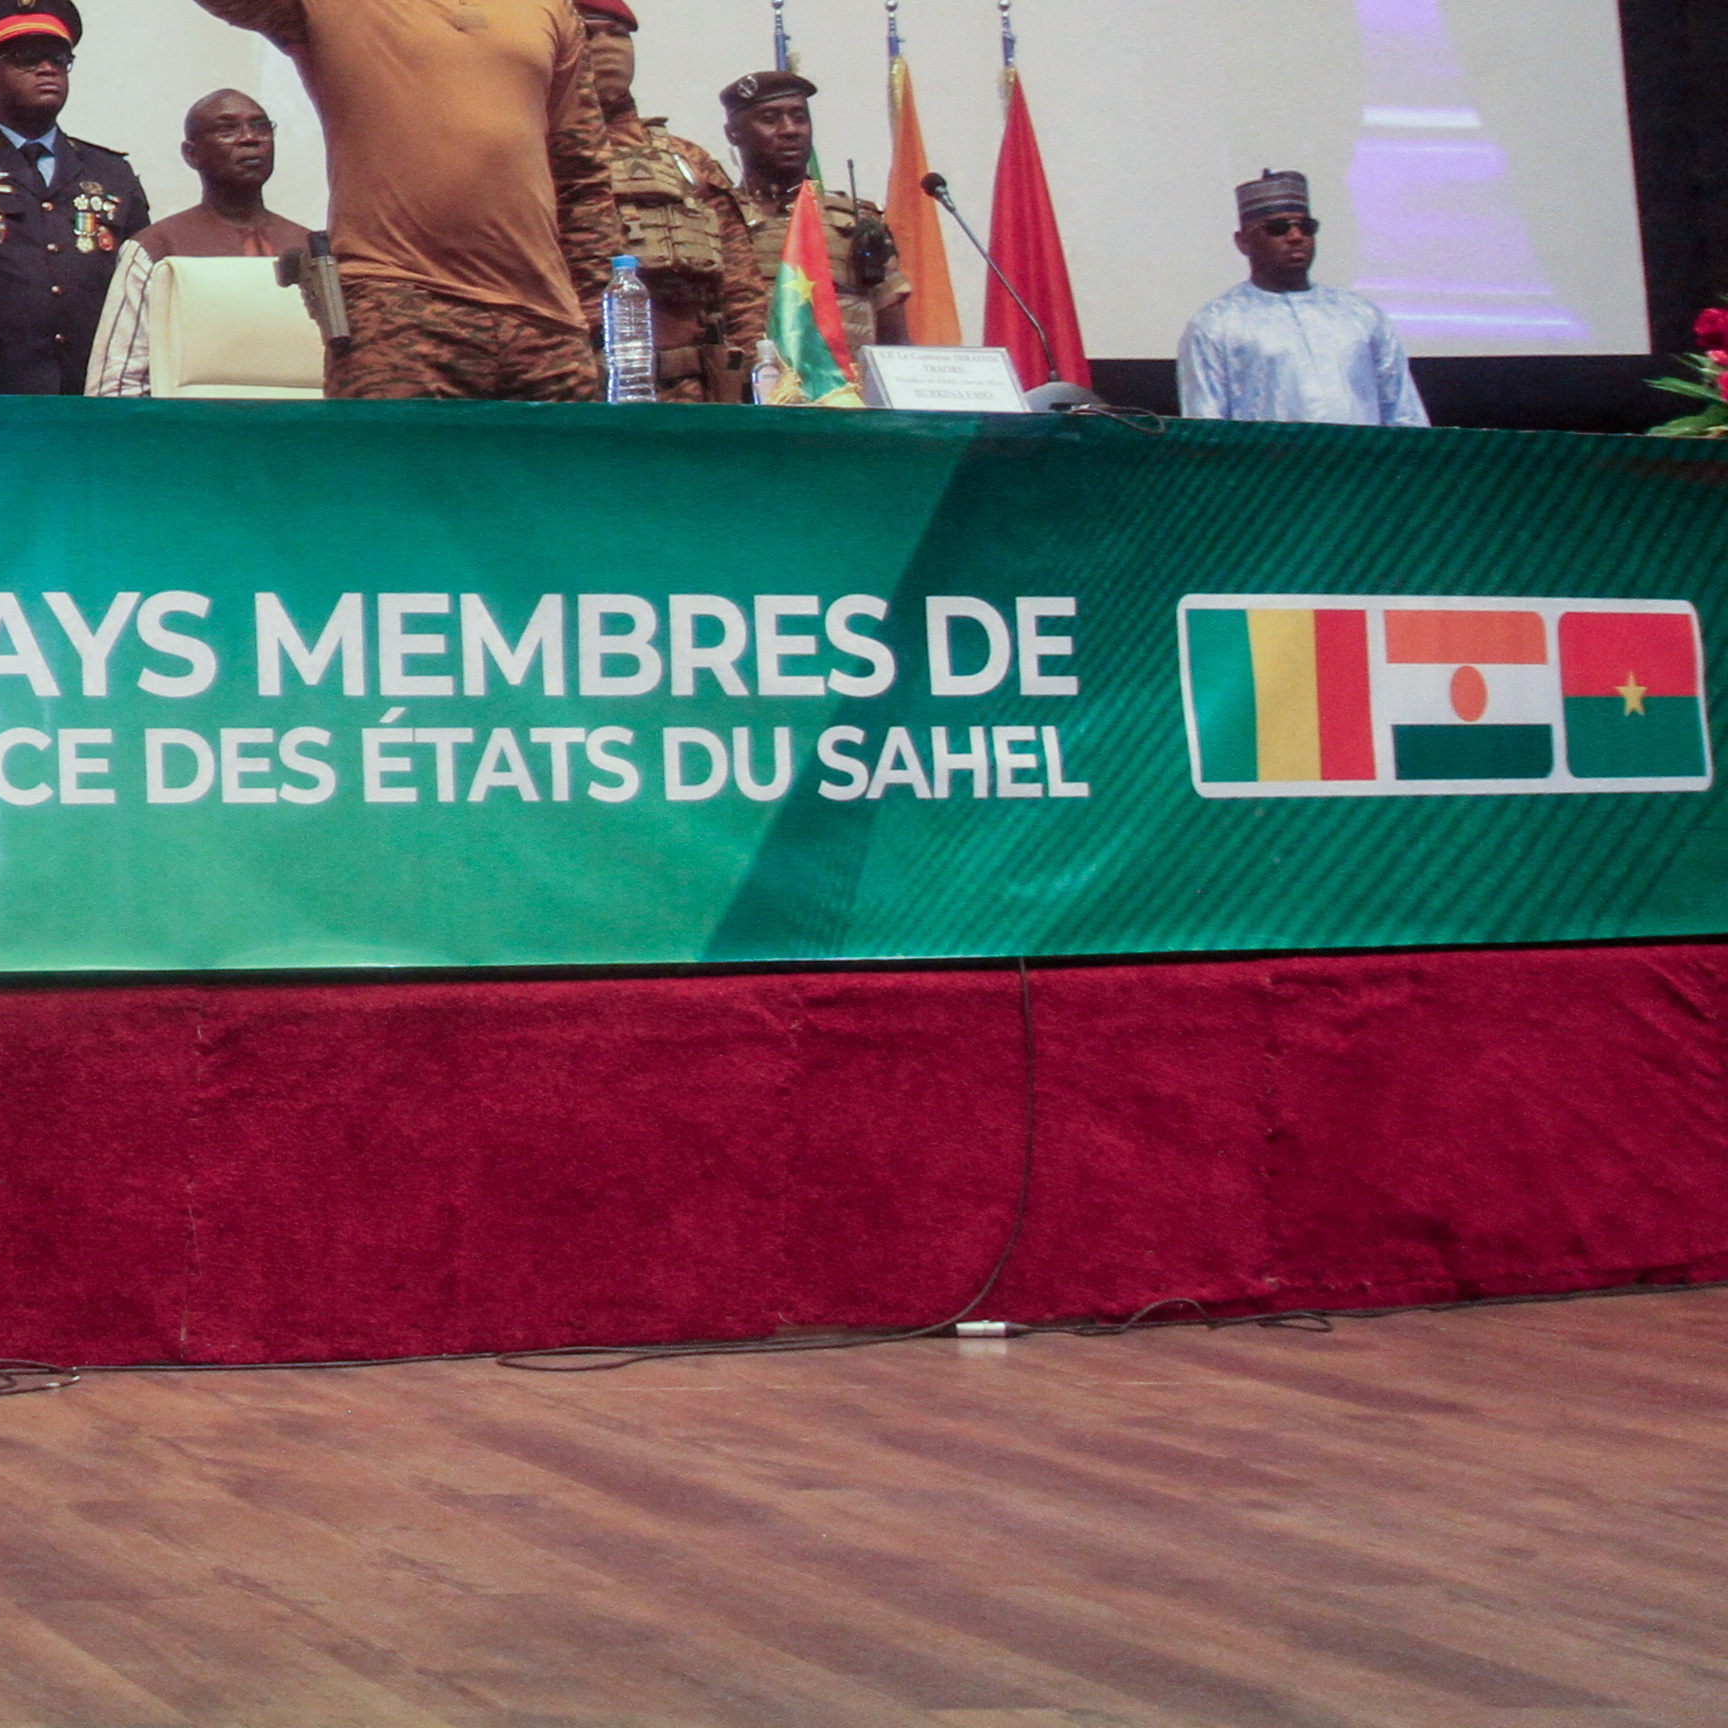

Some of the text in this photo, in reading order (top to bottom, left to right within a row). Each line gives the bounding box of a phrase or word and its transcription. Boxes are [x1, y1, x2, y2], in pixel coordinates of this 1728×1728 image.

[254, 592, 896, 698] MEMBRES
[925, 595, 1080, 696] DE
[145, 726, 337, 805] DES
[361, 706, 641, 804] ÉTATS
[662, 727, 793, 802] DU
[817, 725, 1091, 801] SAHEL
